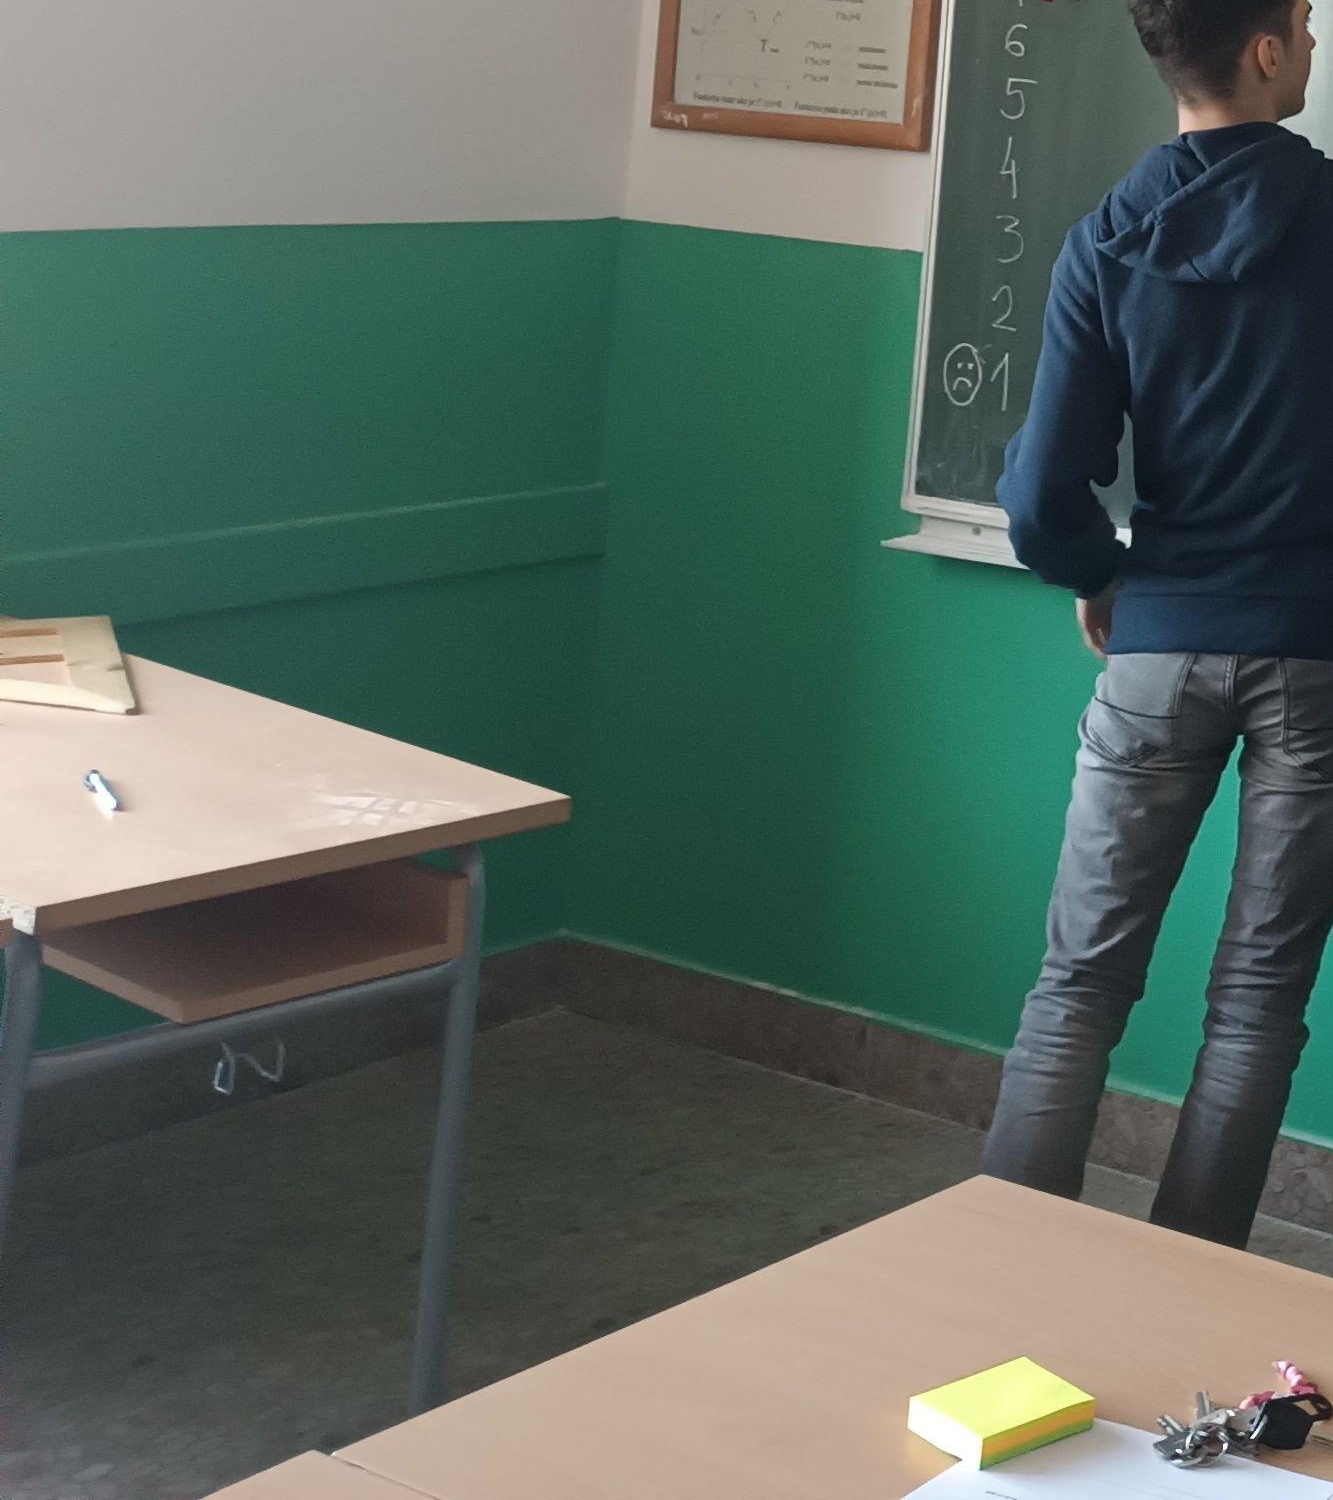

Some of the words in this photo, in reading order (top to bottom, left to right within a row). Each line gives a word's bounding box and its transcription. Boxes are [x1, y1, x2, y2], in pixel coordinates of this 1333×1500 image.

[1004, 23, 1028, 57] 6
[1000, 77, 1038, 120] 5
[999, 136, 1019, 199] 4
[995, 215, 1025, 263] 3
[991, 285, 1017, 332] 2
[989, 352, 1010, 412] 1
